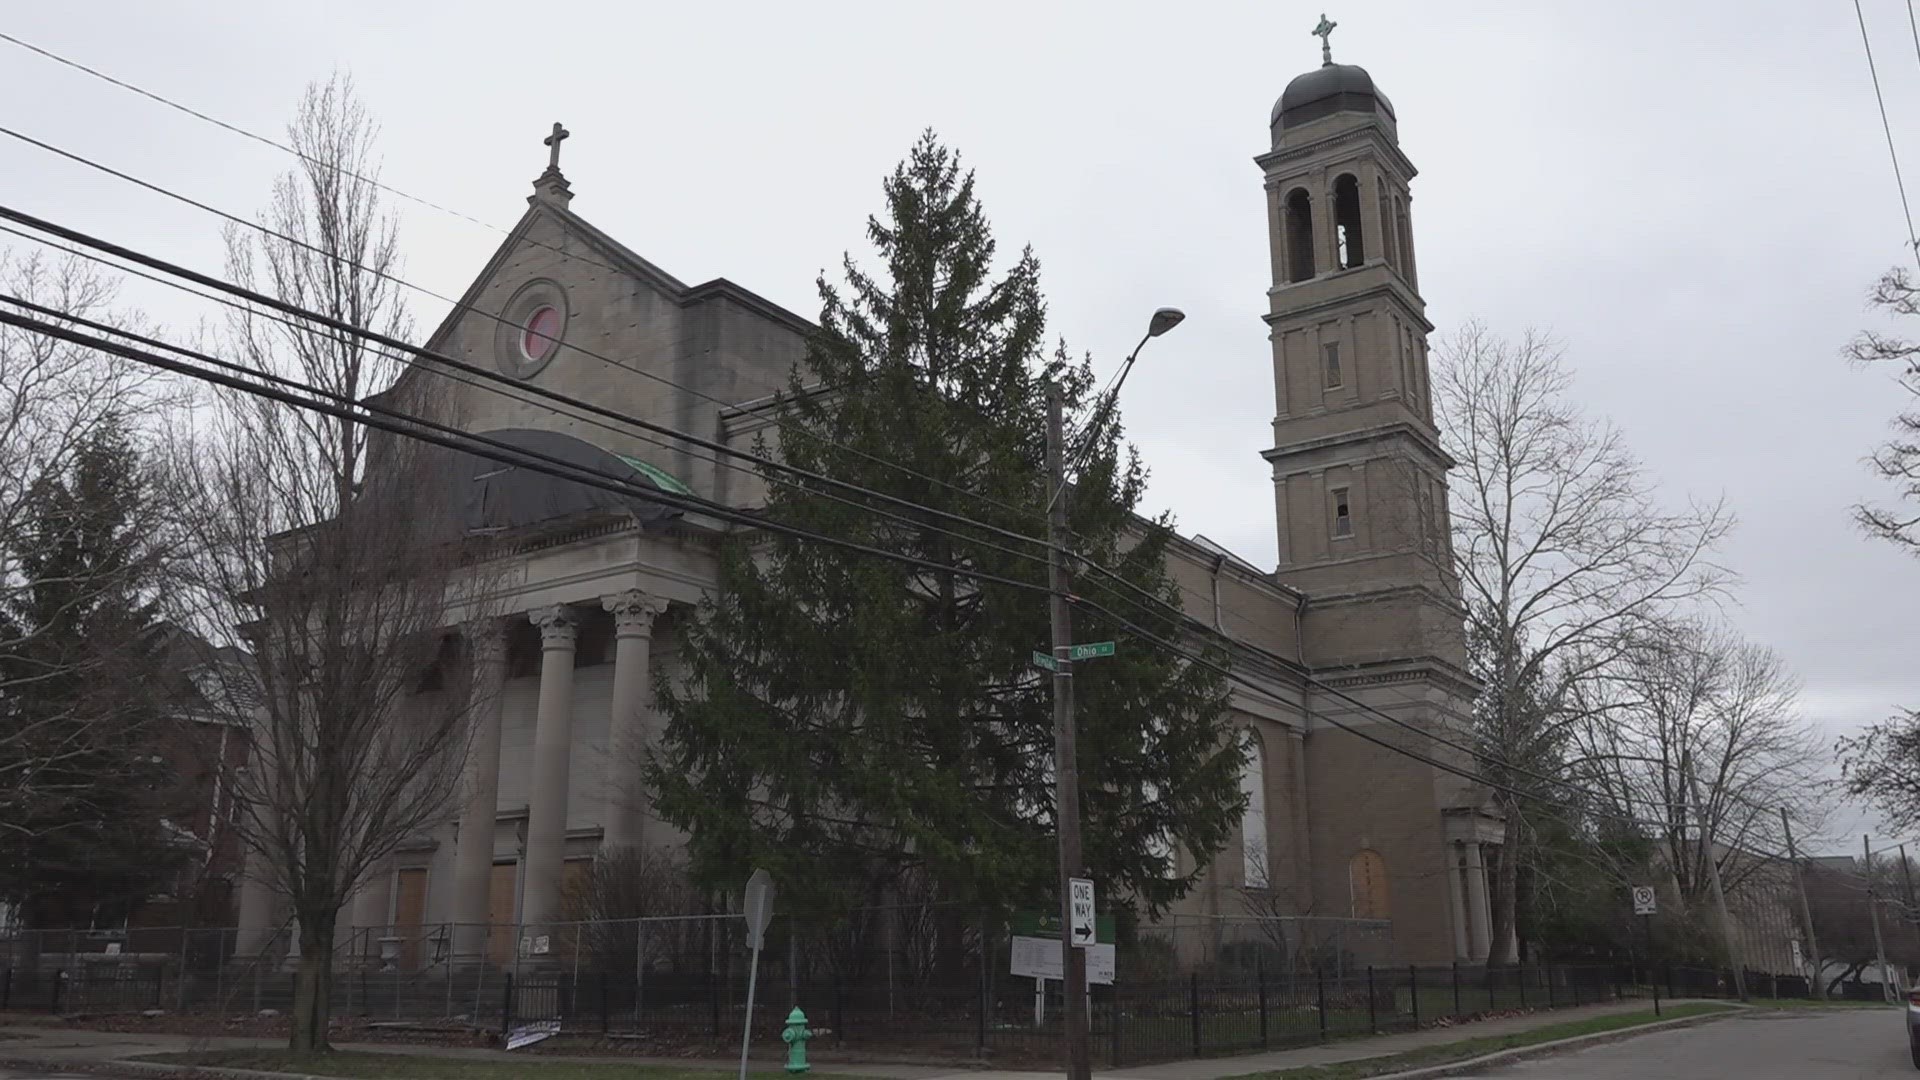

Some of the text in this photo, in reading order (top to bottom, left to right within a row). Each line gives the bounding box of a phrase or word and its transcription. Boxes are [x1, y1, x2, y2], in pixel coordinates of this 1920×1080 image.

[1077, 647, 1097, 657] Ohio
[1074, 885, 1090, 900] ONE
[1075, 903, 1091, 917] WAY
